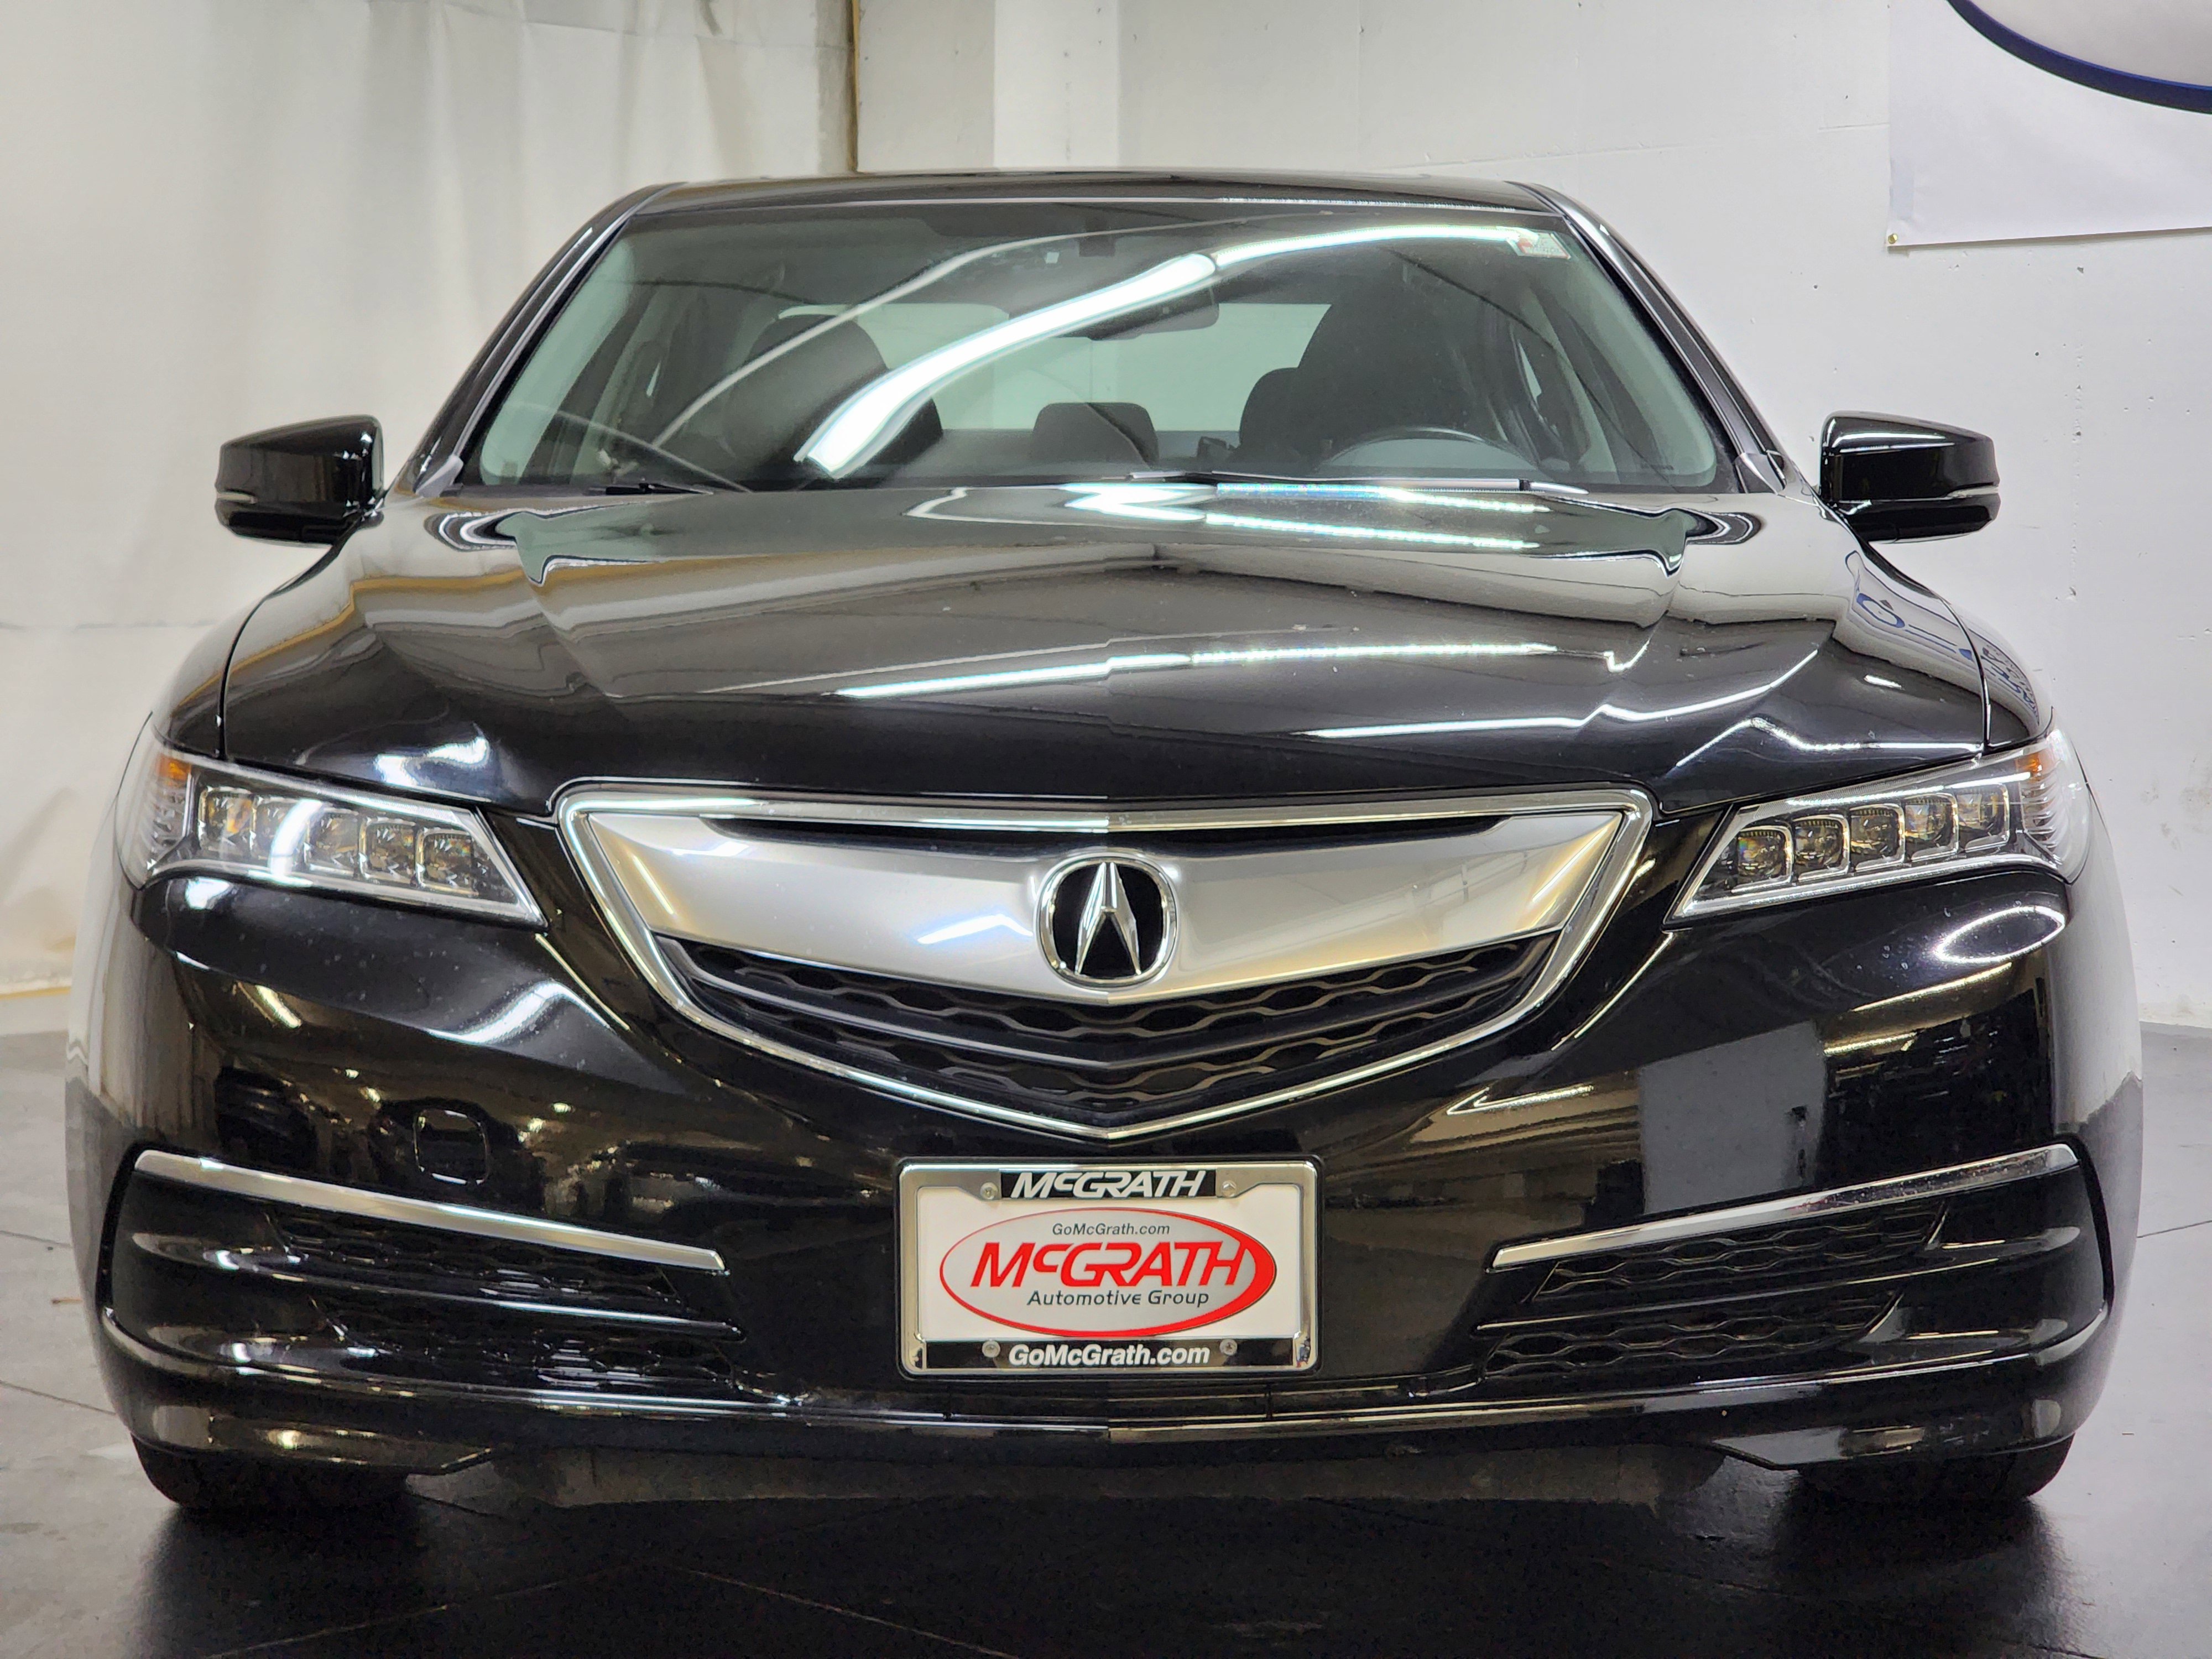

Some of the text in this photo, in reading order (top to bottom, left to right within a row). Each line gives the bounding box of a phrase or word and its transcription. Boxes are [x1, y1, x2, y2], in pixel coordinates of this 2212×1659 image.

[1052, 1222, 1170, 1235] GoMcGrath.com
[1026, 1290, 1209, 1308] Automotive Group
[1009, 1344, 1211, 1366] GoMcGrath.com
